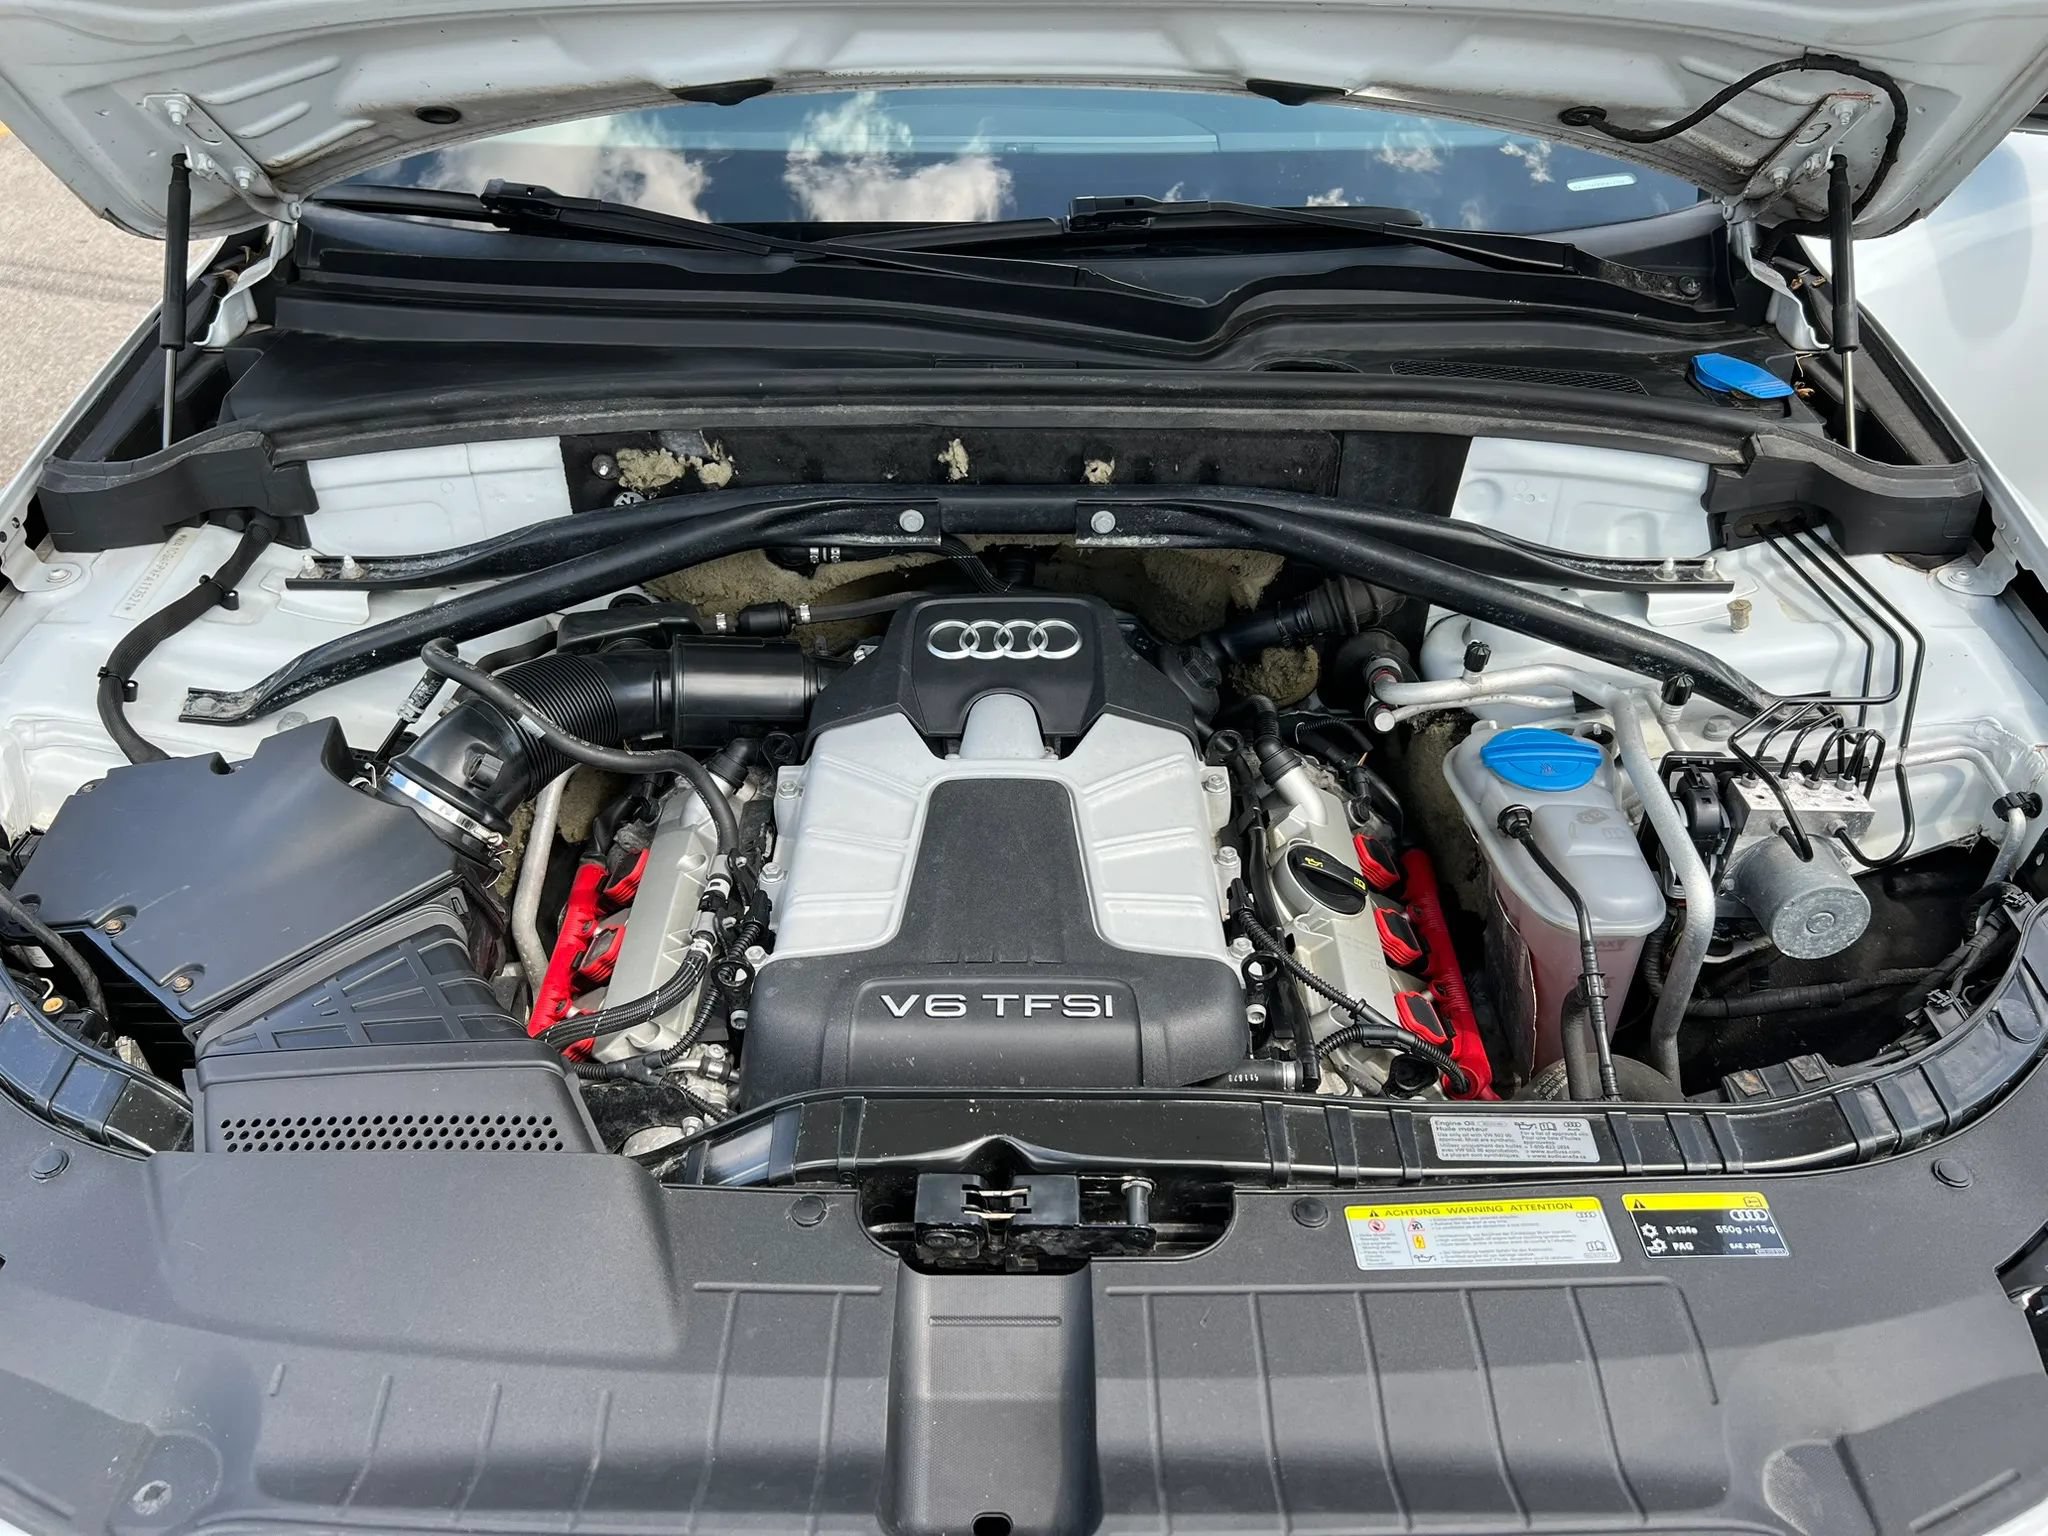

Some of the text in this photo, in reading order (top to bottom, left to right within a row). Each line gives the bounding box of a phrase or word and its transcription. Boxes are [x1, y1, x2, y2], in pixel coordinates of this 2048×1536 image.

[880, 994, 1114, 1018] V6 TFSI
[1385, 1202, 1574, 1217] ACHTUNG WARNING ATTENTION
[1715, 1224, 1743, 1235] 550g
[1672, 1242, 1694, 1251] PAG
